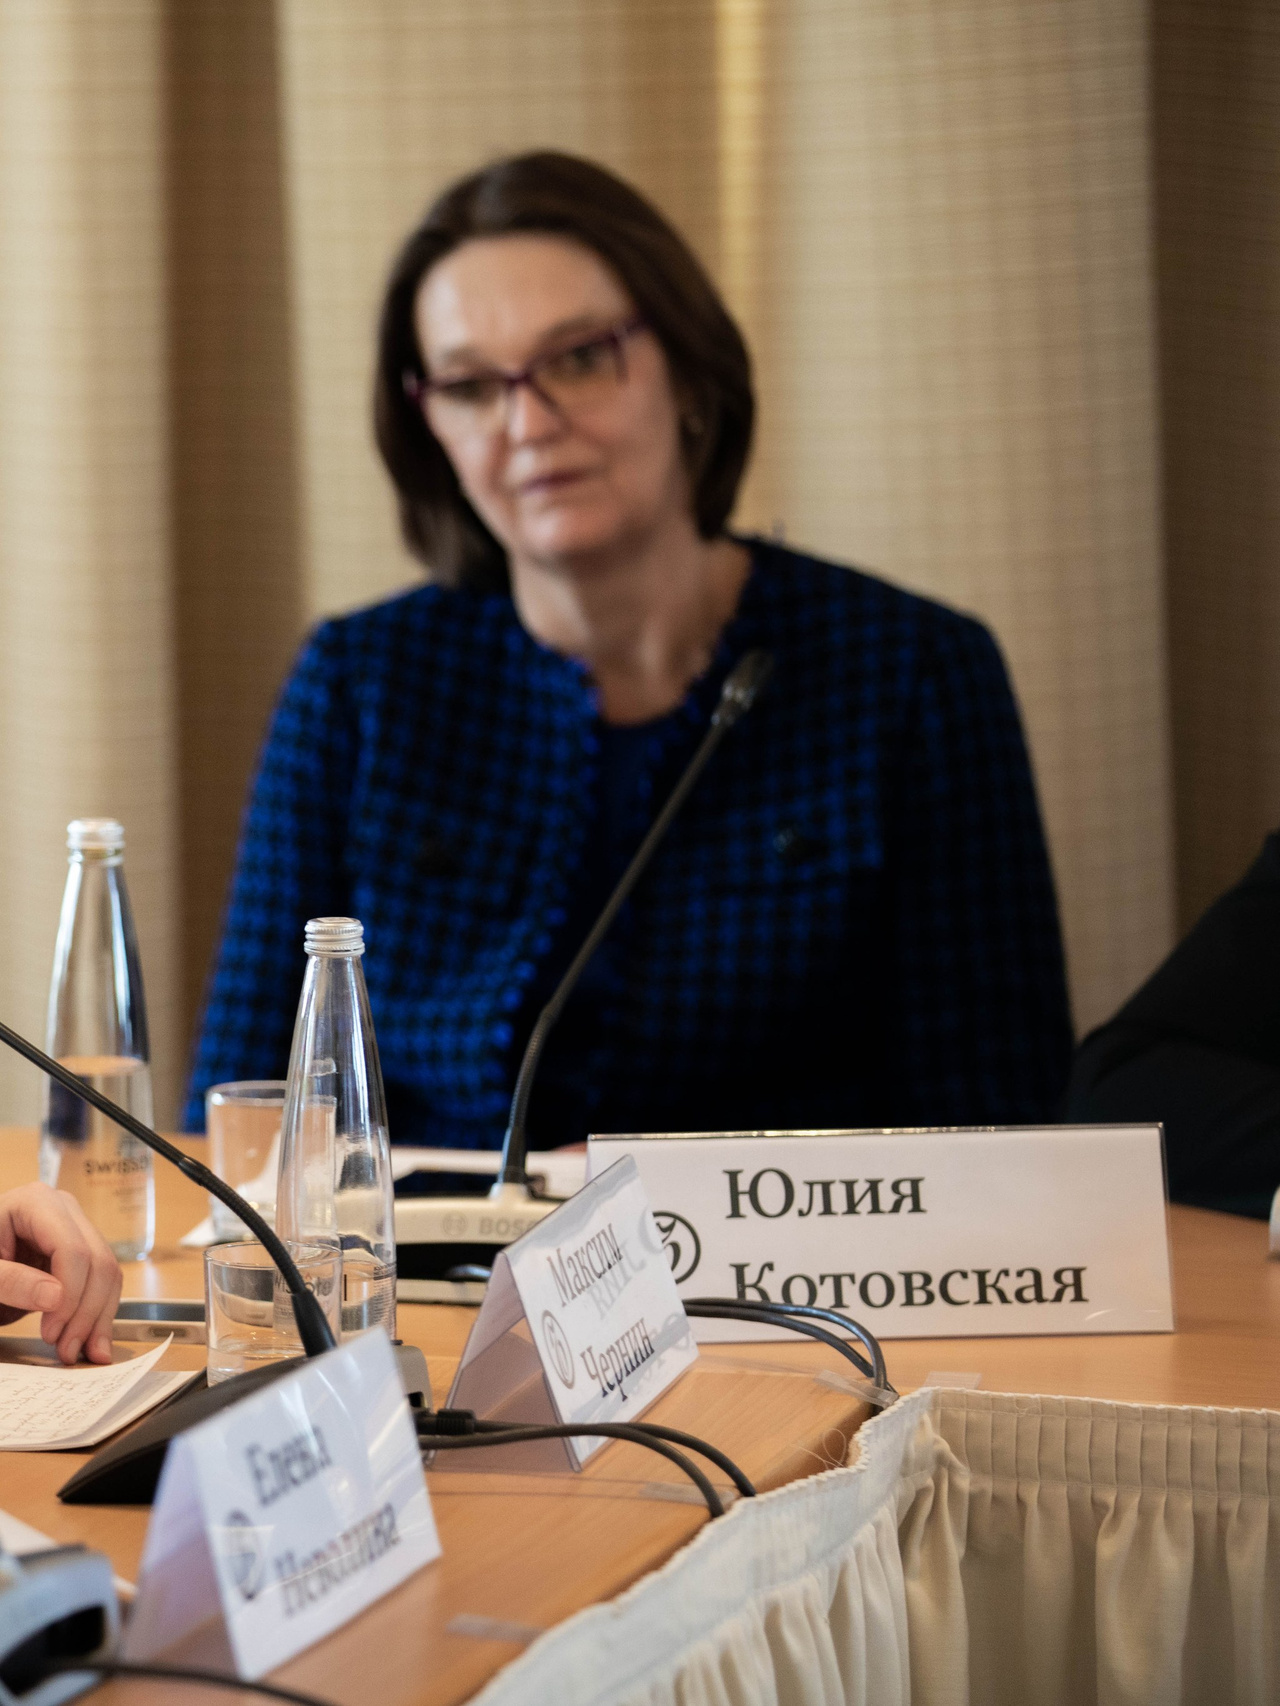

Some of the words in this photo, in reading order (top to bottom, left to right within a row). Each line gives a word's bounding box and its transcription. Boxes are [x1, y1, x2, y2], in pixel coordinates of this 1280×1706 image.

[722, 1167, 927, 1219] Юлия
[547, 1223, 624, 1308] Максим
[729, 1261, 1089, 1309] Котовская
[579, 1317, 656, 1402] Чернин
